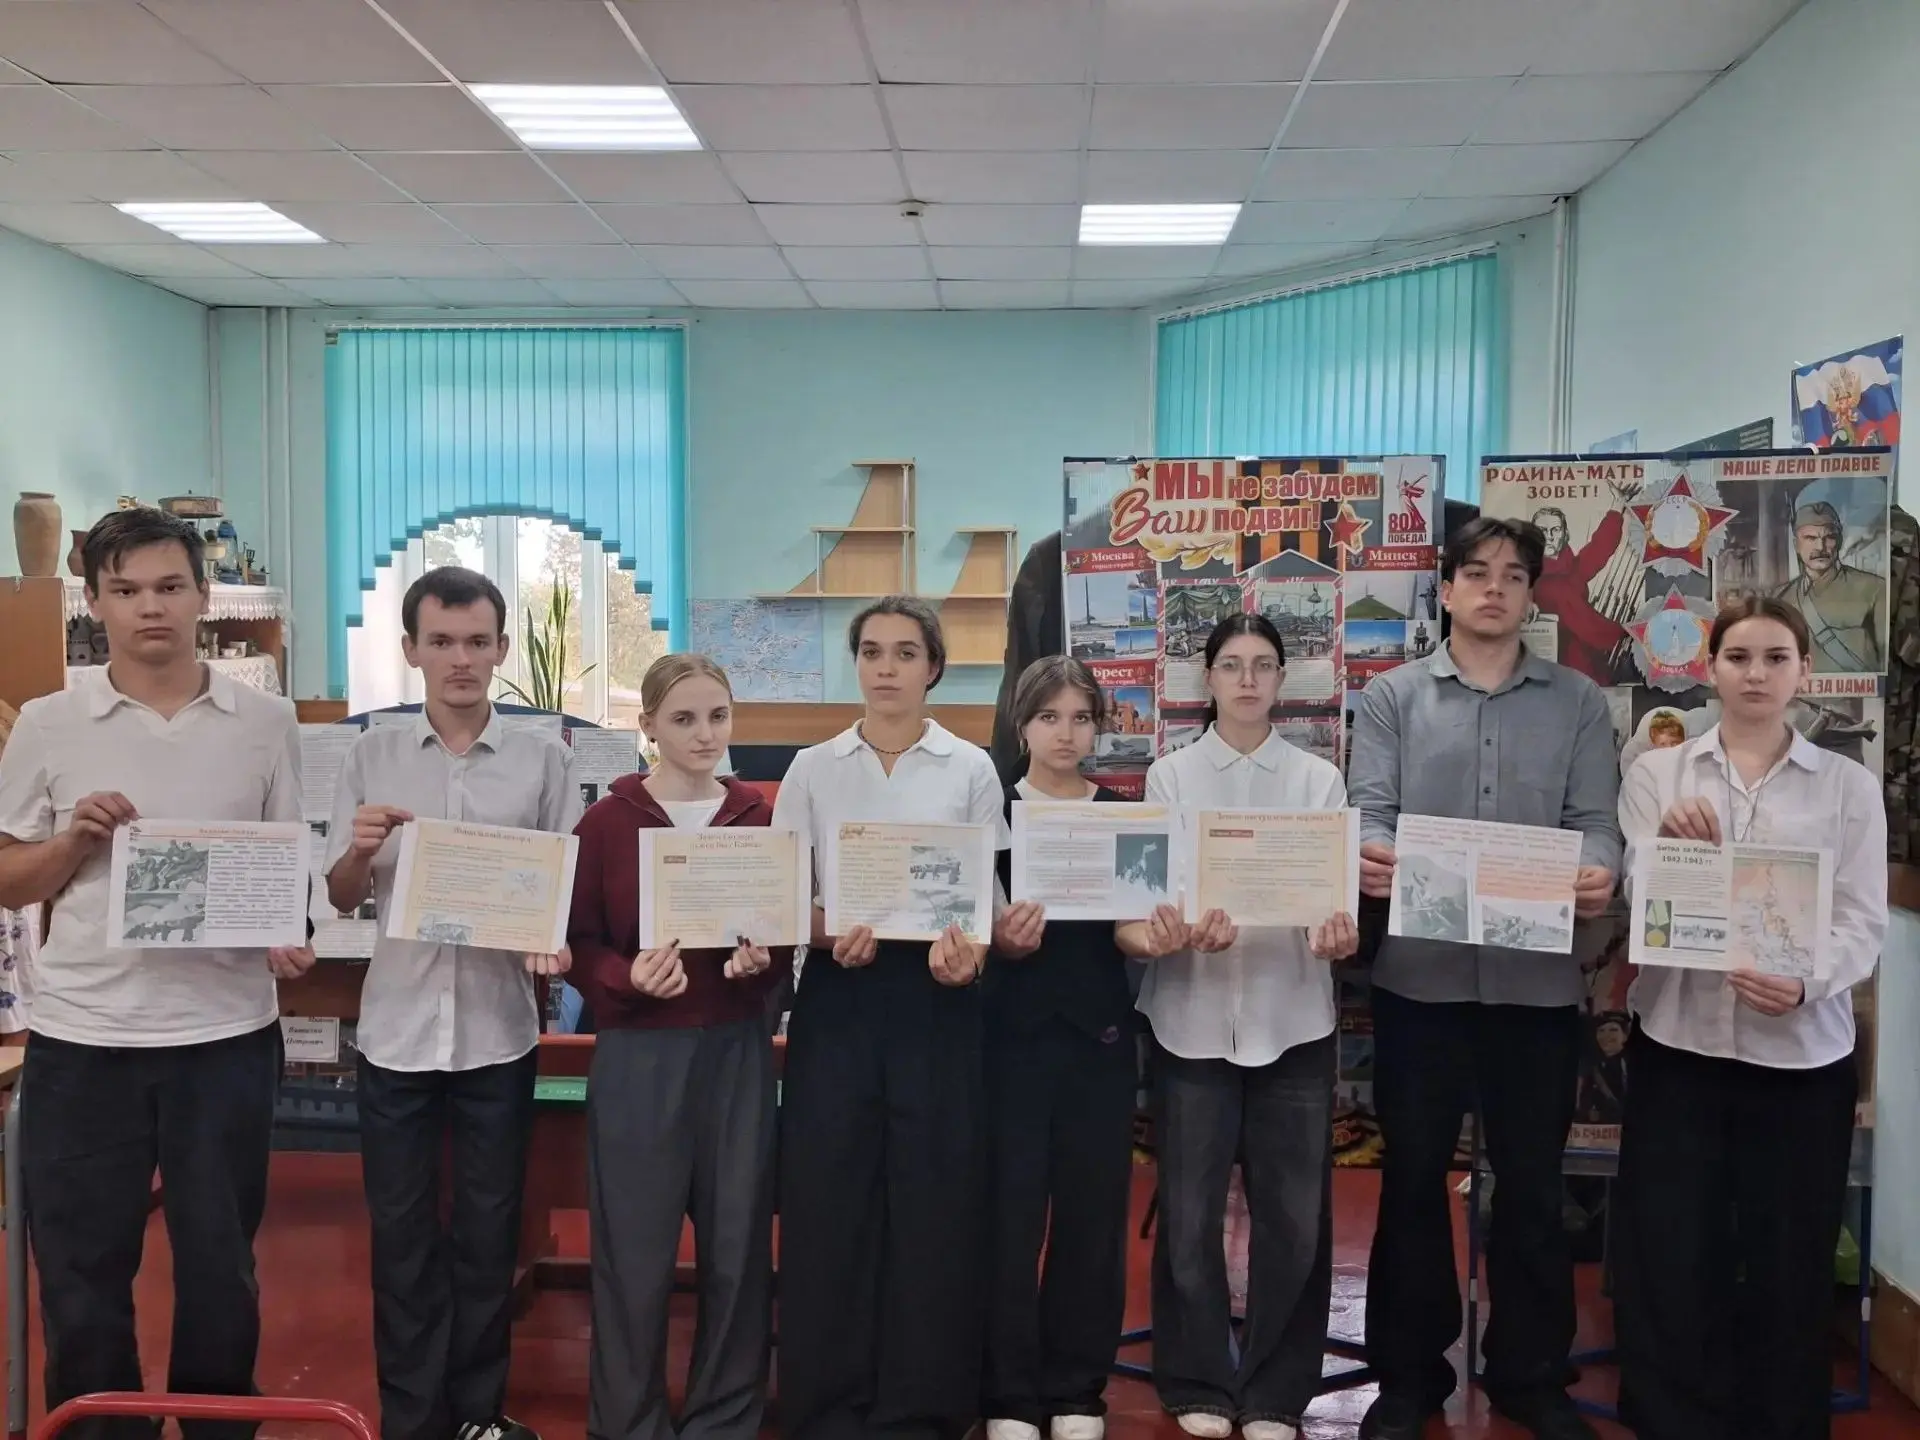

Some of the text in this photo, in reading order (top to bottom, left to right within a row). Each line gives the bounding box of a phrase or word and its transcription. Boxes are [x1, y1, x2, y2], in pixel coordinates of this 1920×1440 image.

[1723, 456, 1880, 476] НАШЕ ДЕЛО ПРАВОЕ
[1154, 461, 1377, 500] МЫ не забудем
[1527, 485, 1599, 499] ЗОВЕТ!
[1112, 488, 1321, 543] Ваш подвиг!
[1388, 533, 1427, 544] ПОБЕДА!
[1091, 552, 1135, 562] Москва
[1369, 550, 1418, 561] Минск
[1836, 678, 1876, 694] НАМИ
